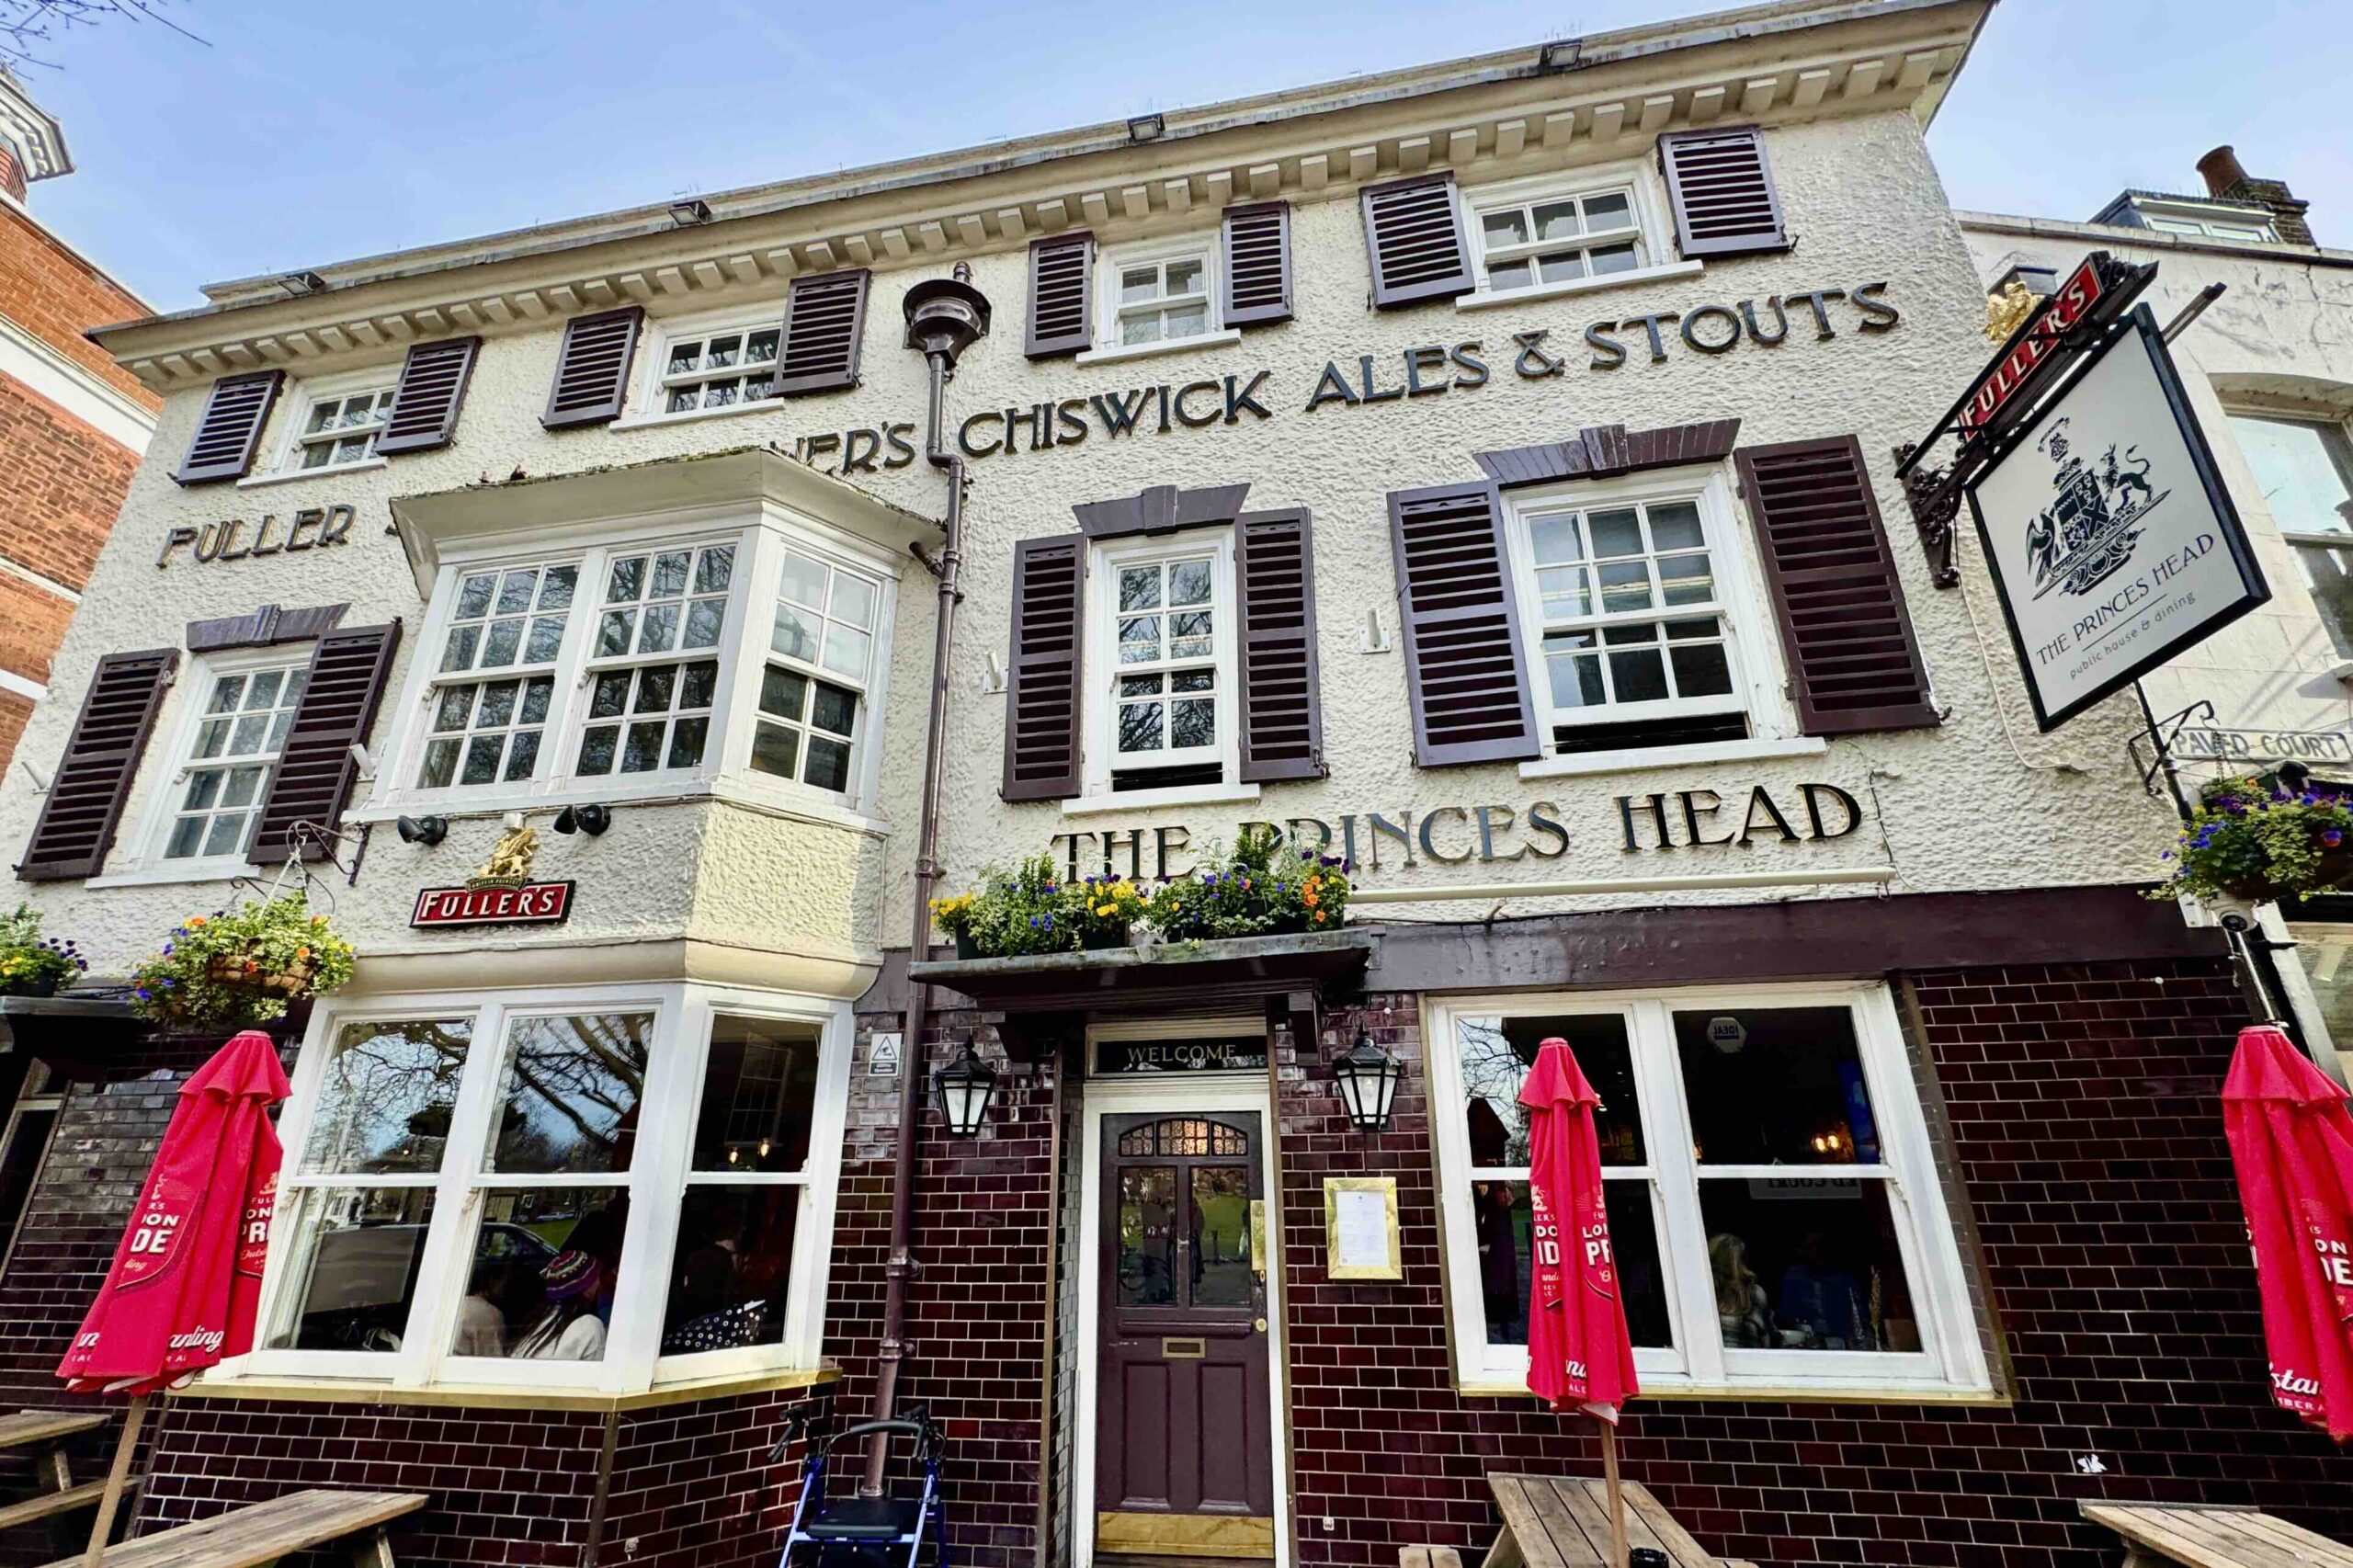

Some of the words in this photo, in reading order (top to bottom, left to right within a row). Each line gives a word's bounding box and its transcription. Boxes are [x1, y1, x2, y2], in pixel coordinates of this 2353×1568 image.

[958, 370, 1272, 458] CHISWICK
[1305, 340, 1491, 412] ALES
[1512, 329, 1564, 379] &
[1584, 281, 1900, 370] STOUTS
[155, 504, 357, 569] FULLER
[2037, 633, 2071, 665] THE
[2074, 577, 2150, 641] PRINCES
[2152, 534, 2214, 585] HEAD
[2070, 653, 2103, 678] public
[2105, 628, 2138, 654] house
[2154, 591, 2196, 622] dining
[2261, 733, 2339, 758] COURT
[1050, 825, 1197, 884] THE
[1613, 783, 1862, 851] HEAD
[421, 887, 555, 917] FULLER'S
[1127, 1044, 1236, 1062] WELCOME
